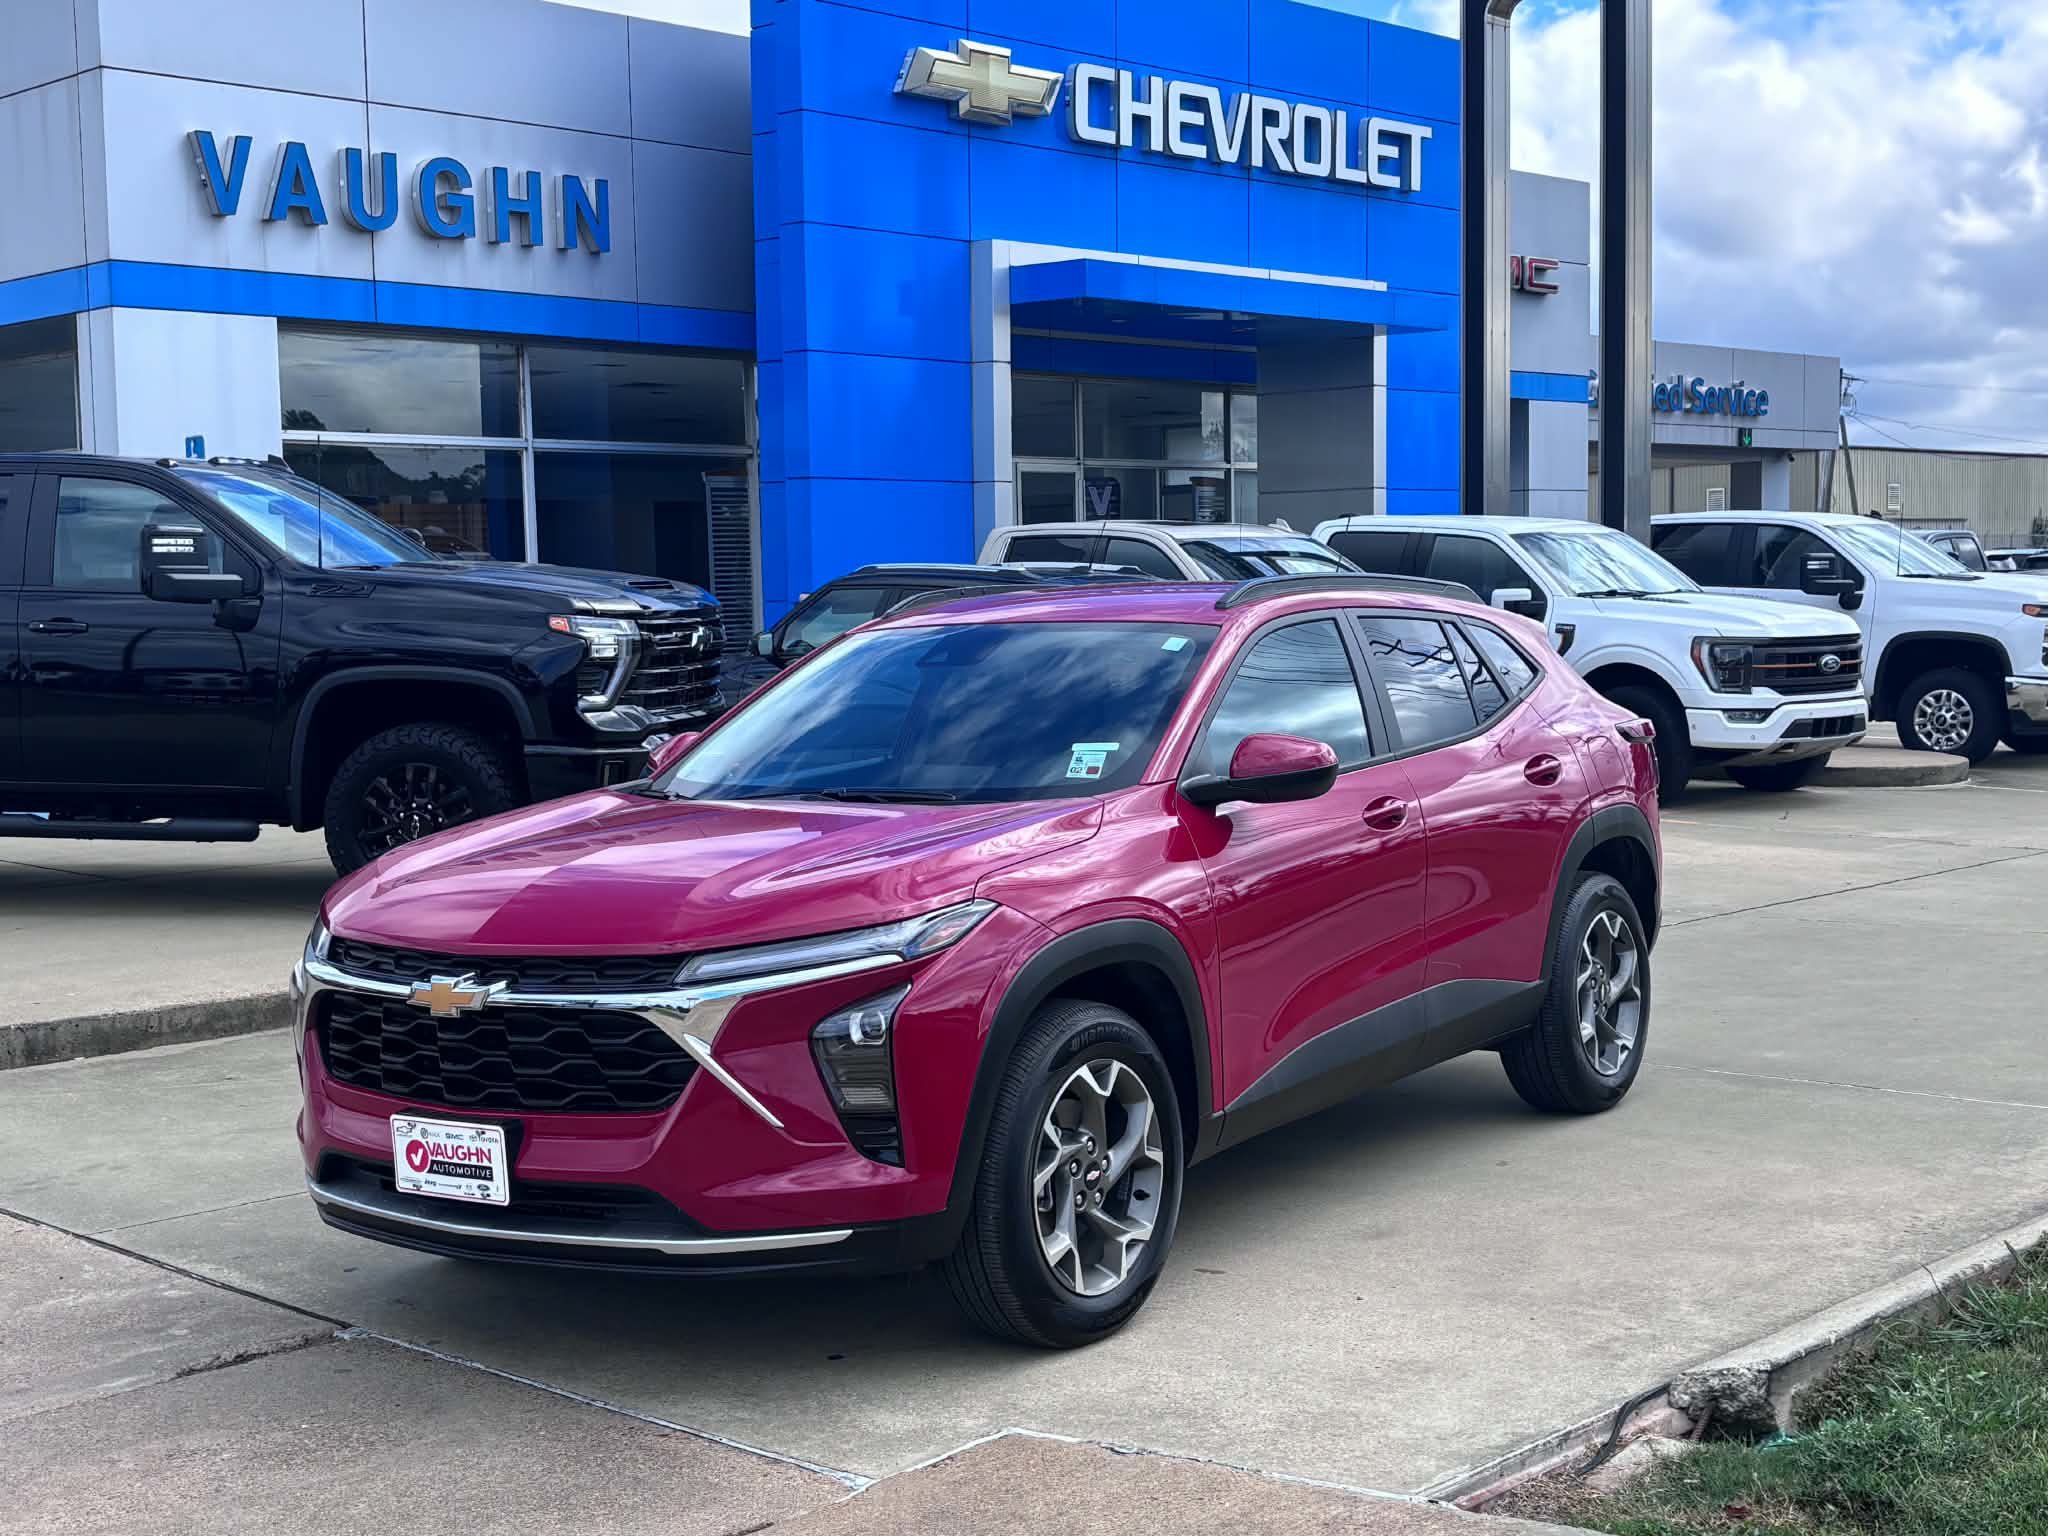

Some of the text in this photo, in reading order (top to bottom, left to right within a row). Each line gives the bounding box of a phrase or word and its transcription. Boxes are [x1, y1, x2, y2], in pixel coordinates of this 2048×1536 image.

[1067, 62, 1433, 193] CHEVROLET
[187, 129, 611, 254] VAUGHN
[1691, 376, 1769, 417] Service
[425, 1141, 492, 1165] VAUGHN
[432, 1162, 492, 1178] AUTOMOTIVE
